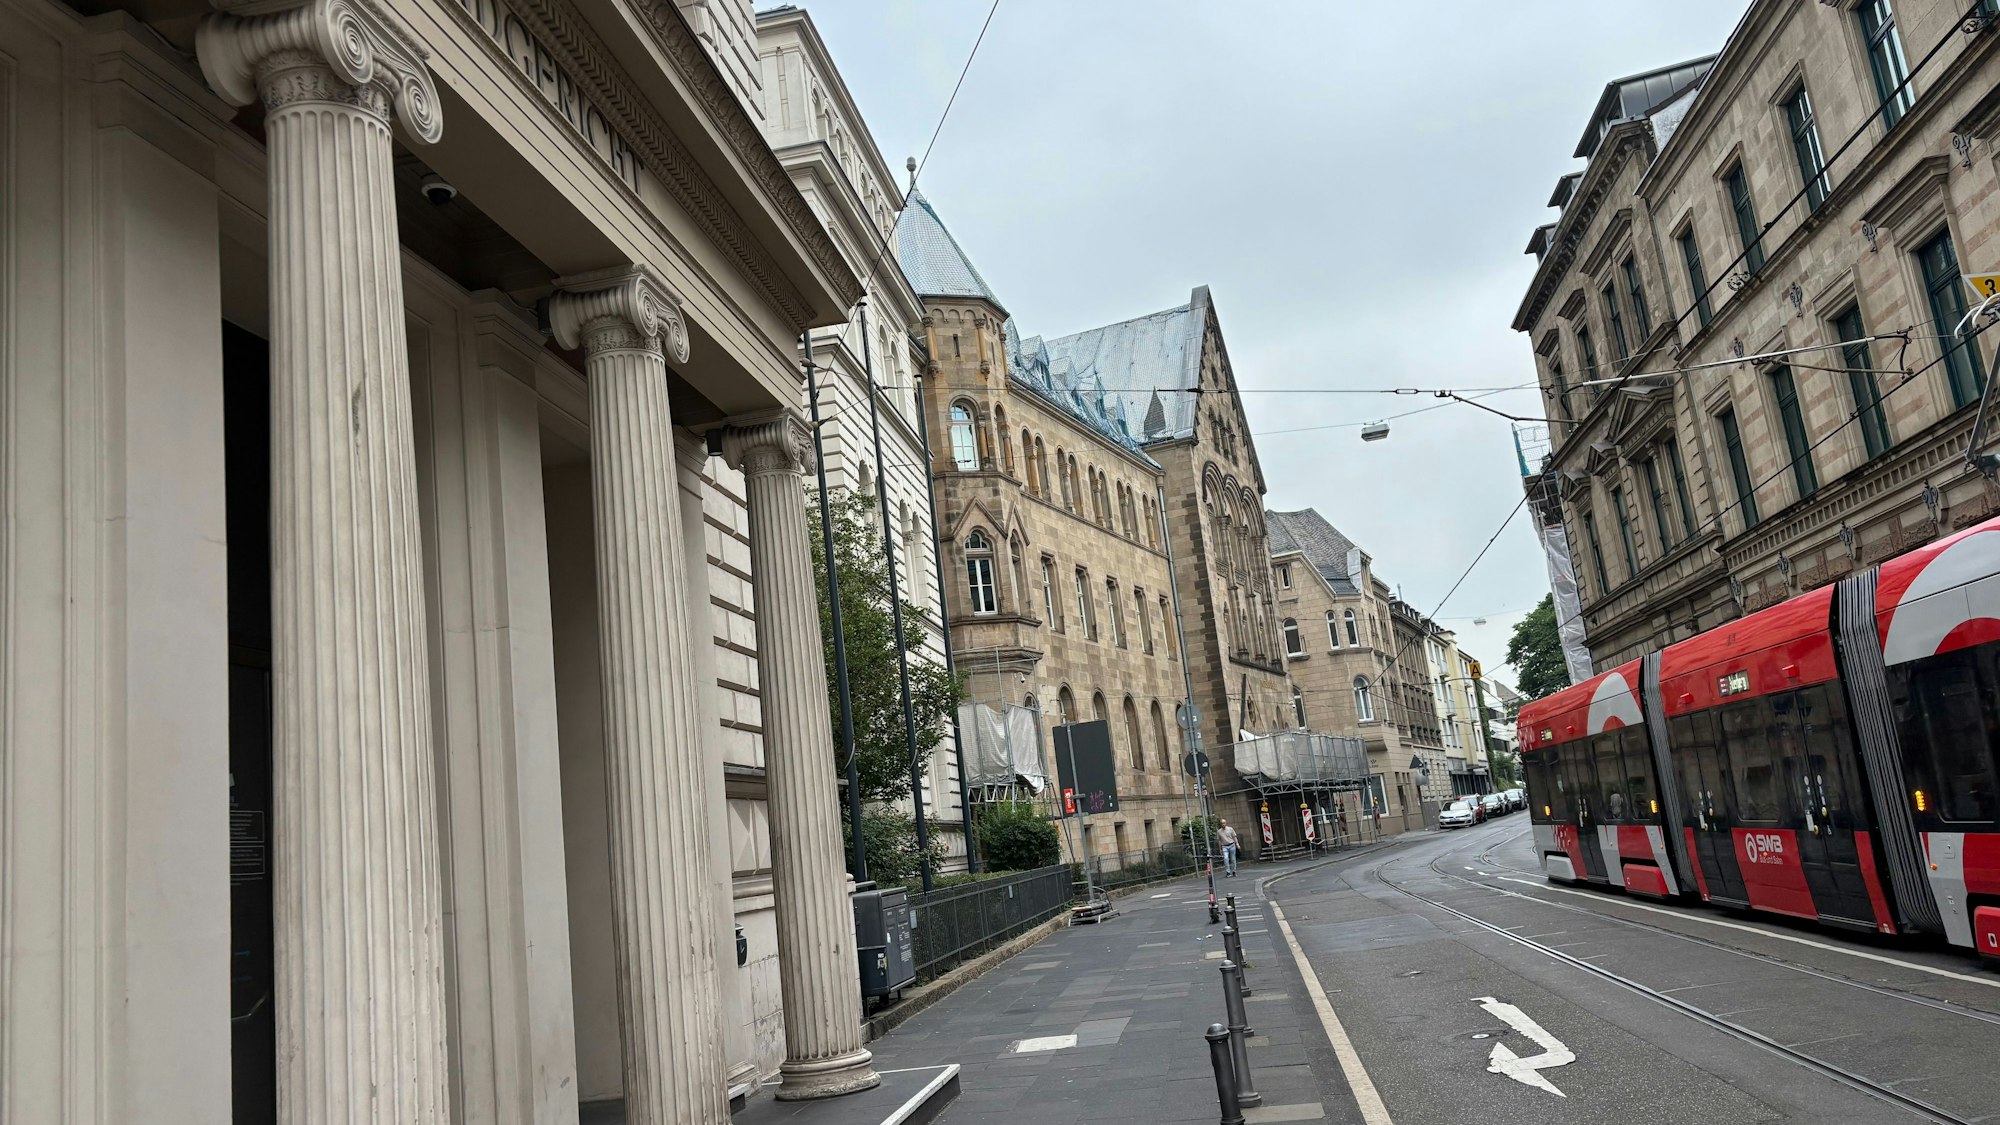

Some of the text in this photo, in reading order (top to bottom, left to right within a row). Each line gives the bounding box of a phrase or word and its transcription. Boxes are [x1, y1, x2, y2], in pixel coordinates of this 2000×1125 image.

[1985, 279, 1996, 298] 3
[1471, 664, 1482, 677] A
[1756, 834, 1783, 853] SWB
